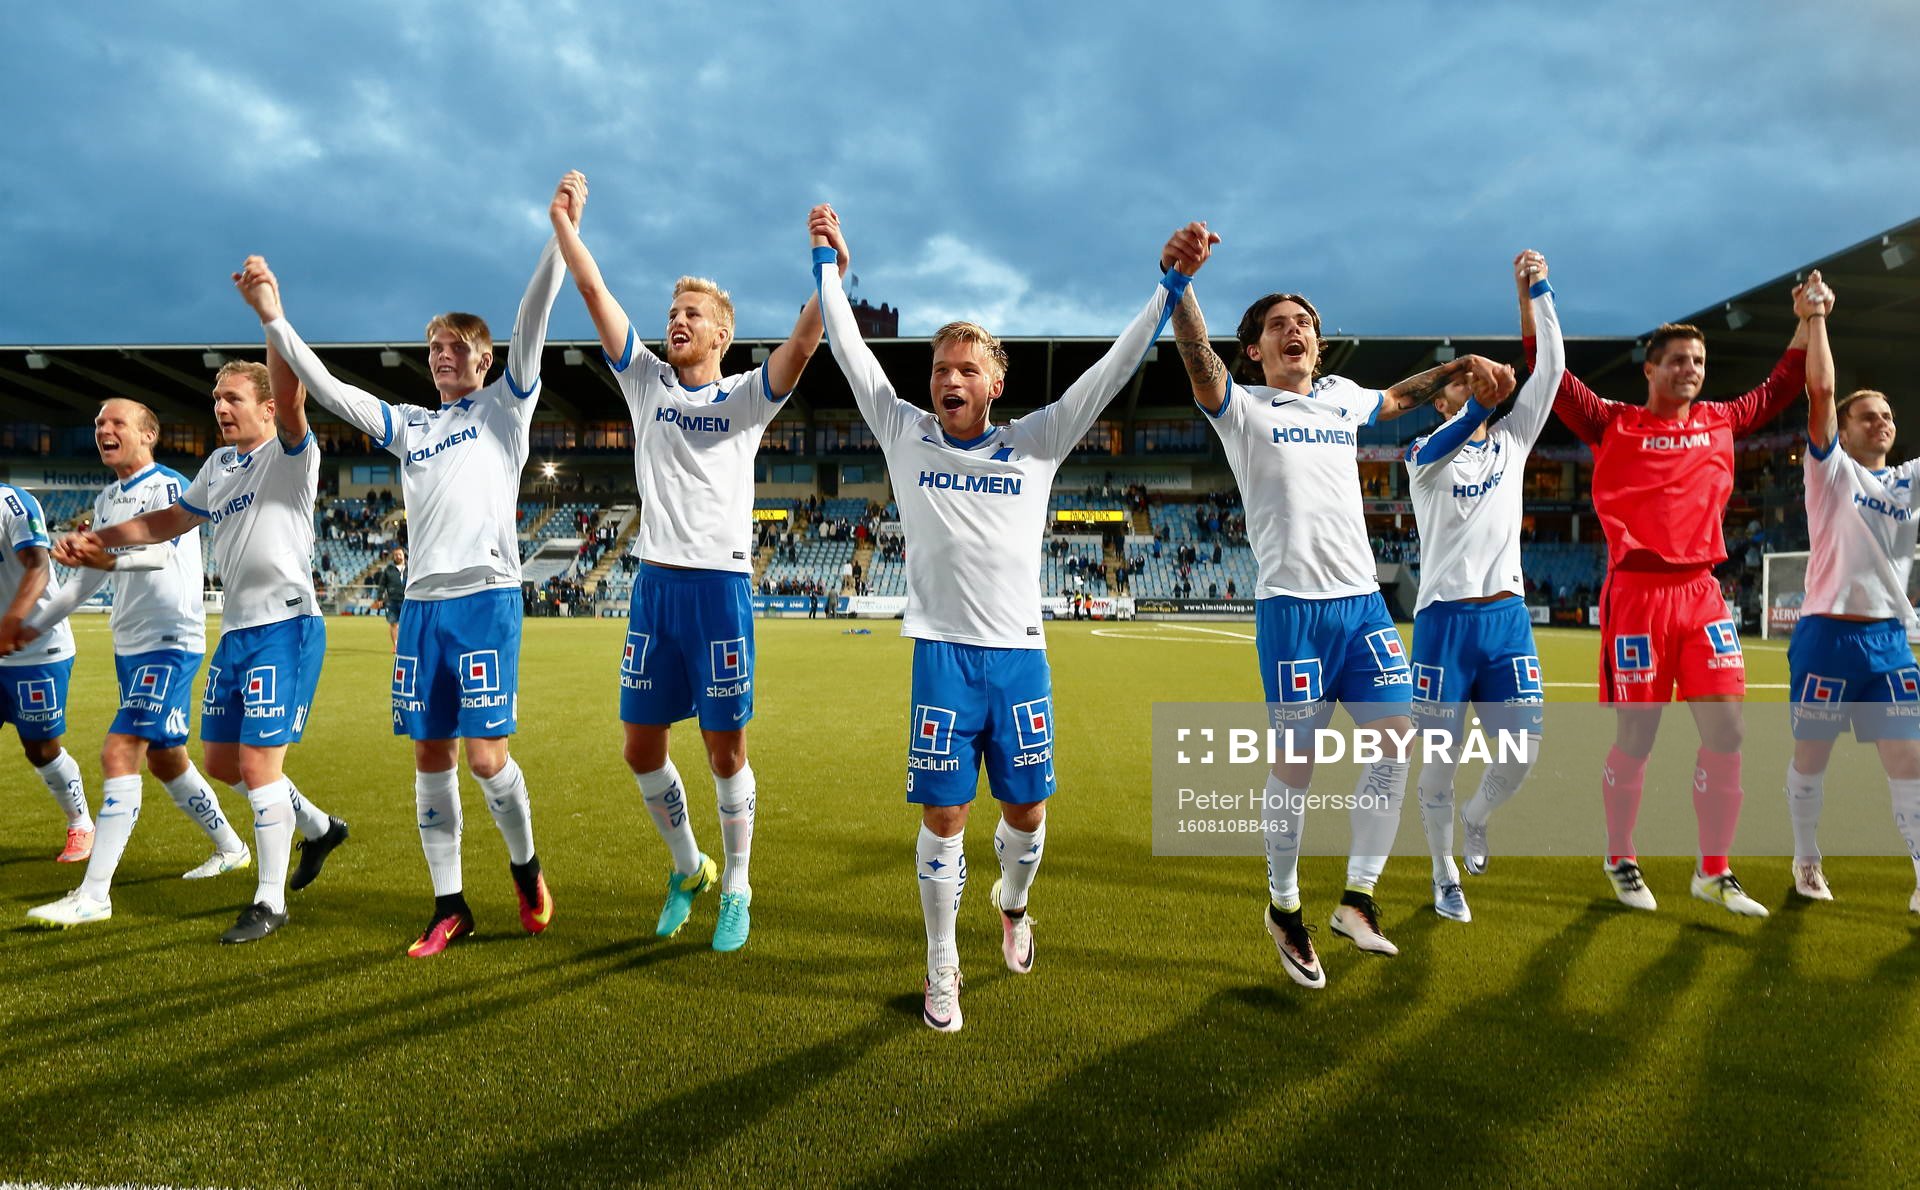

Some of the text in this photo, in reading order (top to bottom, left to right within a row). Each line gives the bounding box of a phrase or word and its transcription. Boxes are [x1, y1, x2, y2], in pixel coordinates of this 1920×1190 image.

[656, 407, 730, 433] HOLMEN
[405, 426, 478, 466] HOLMEN
[1272, 427, 1355, 447] HOLMEN
[918, 470, 1022, 495] HOLMEN
[621, 675, 652, 690] dium
[707, 680, 750, 698] stadium
[1374, 672, 1411, 687] stadi
[123, 698, 162, 714] adium
[244, 704, 285, 718] adium
[1275, 700, 1327, 720] stadium
[1276, 720, 1285, 739] 9
